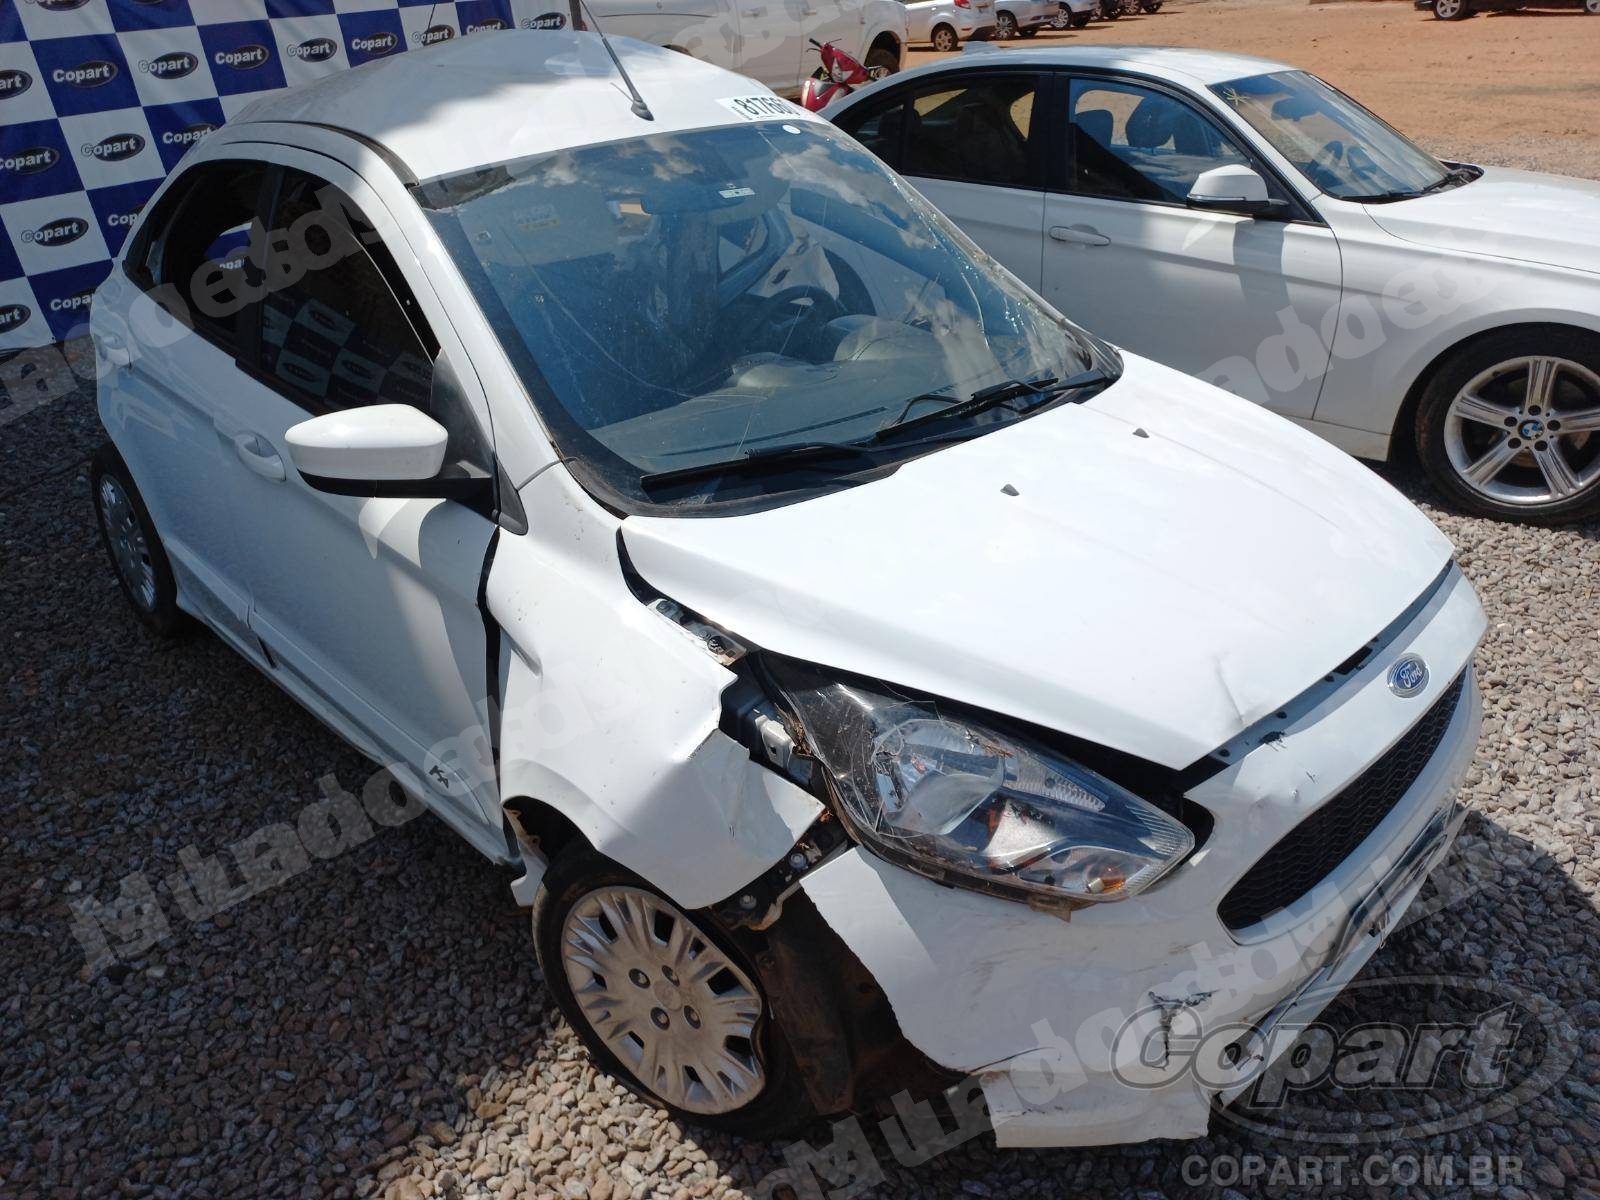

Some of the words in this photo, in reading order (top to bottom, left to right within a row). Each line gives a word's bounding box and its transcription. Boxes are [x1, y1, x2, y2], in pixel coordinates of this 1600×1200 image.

[520, 16, 561, 30] Copart
[352, 34, 392, 51] Copart
[412, 28, 450, 44] Copart
[215, 47, 263, 66] Copart
[287, 42, 331, 58] Copart
[138, 56, 191, 74] Copart
[0, 75, 22, 90] art
[53, 65, 110, 84] Copart
[81, 137, 136, 156] Copart
[108, 212, 141, 228] Cop
[21, 221, 79, 242] Copart
[51, 293, 94, 312] Copa
[0, 309, 20, 324] art
[1399, 661, 1422, 688] Ford
